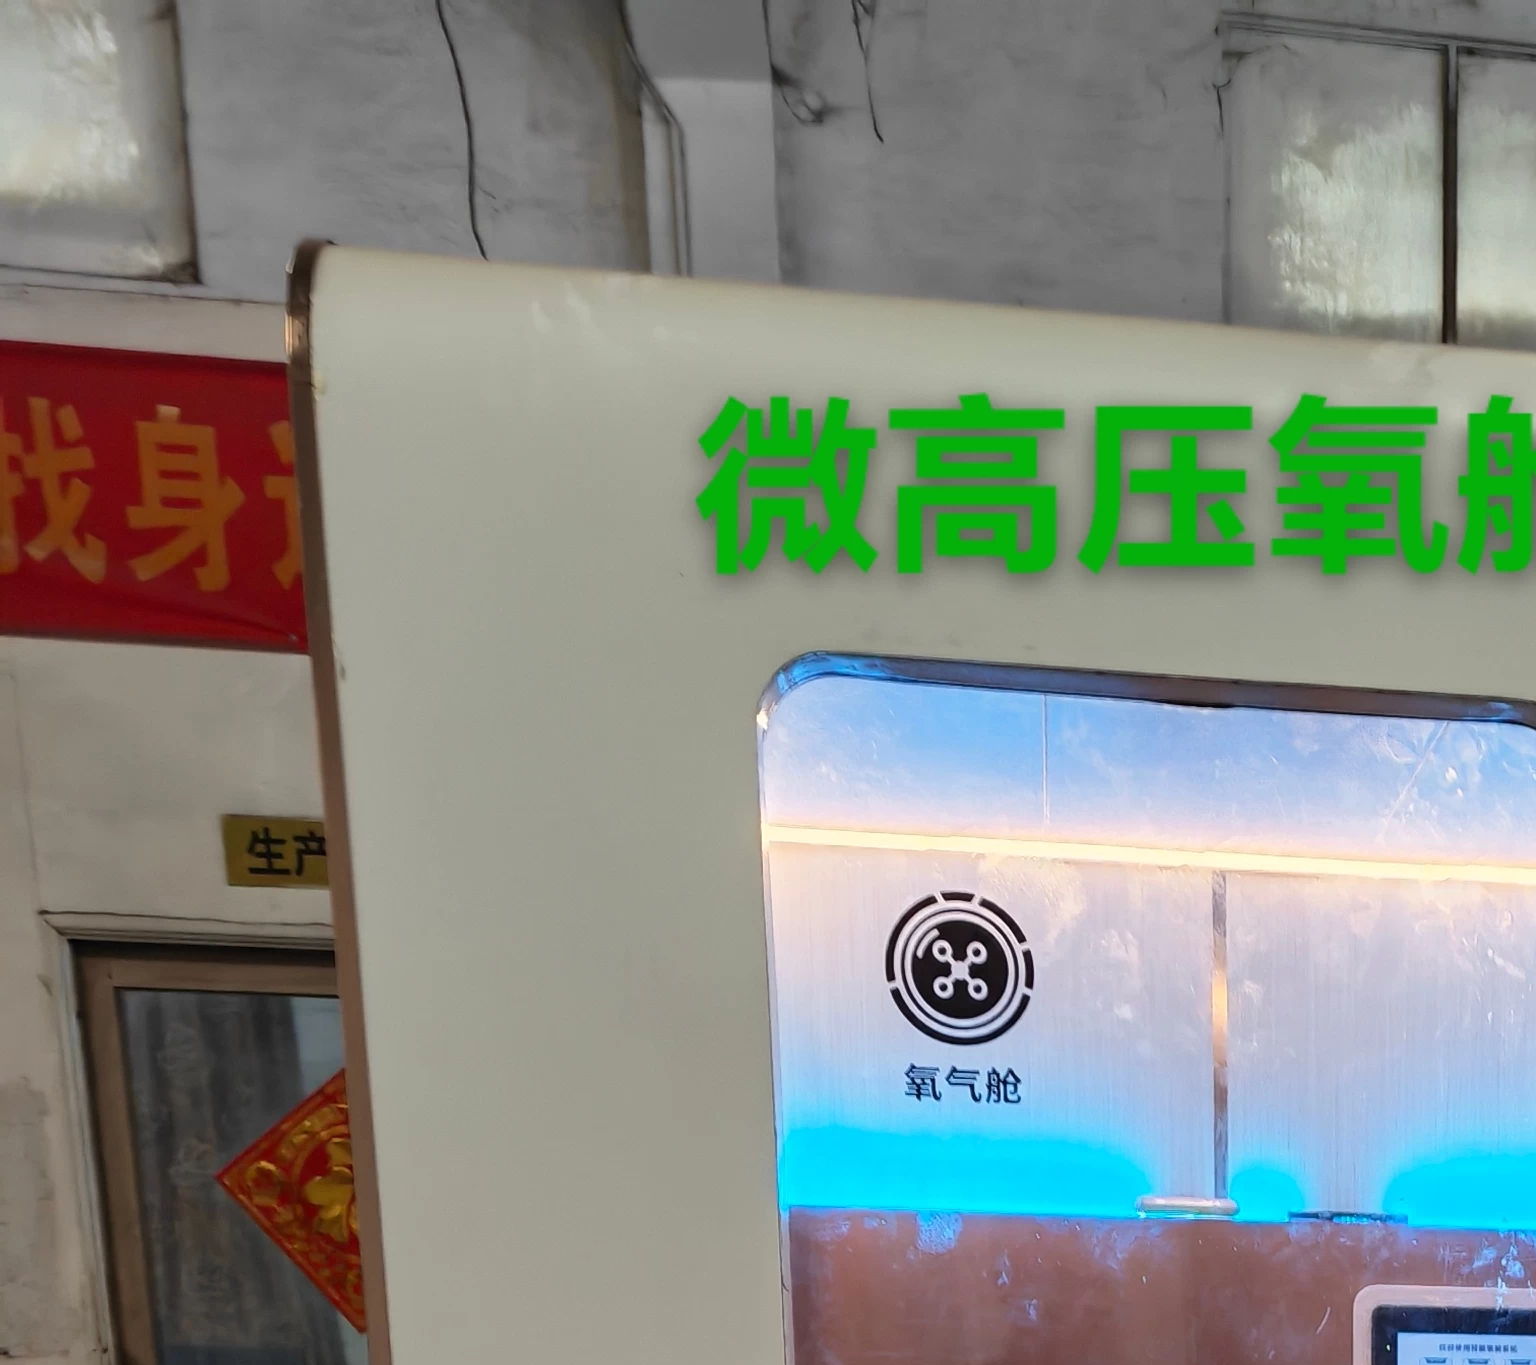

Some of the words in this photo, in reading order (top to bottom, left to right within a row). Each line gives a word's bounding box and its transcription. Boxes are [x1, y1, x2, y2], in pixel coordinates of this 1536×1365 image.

[247, 827, 326, 876] 生产
[904, 1063, 1022, 1104] 氧气舱
